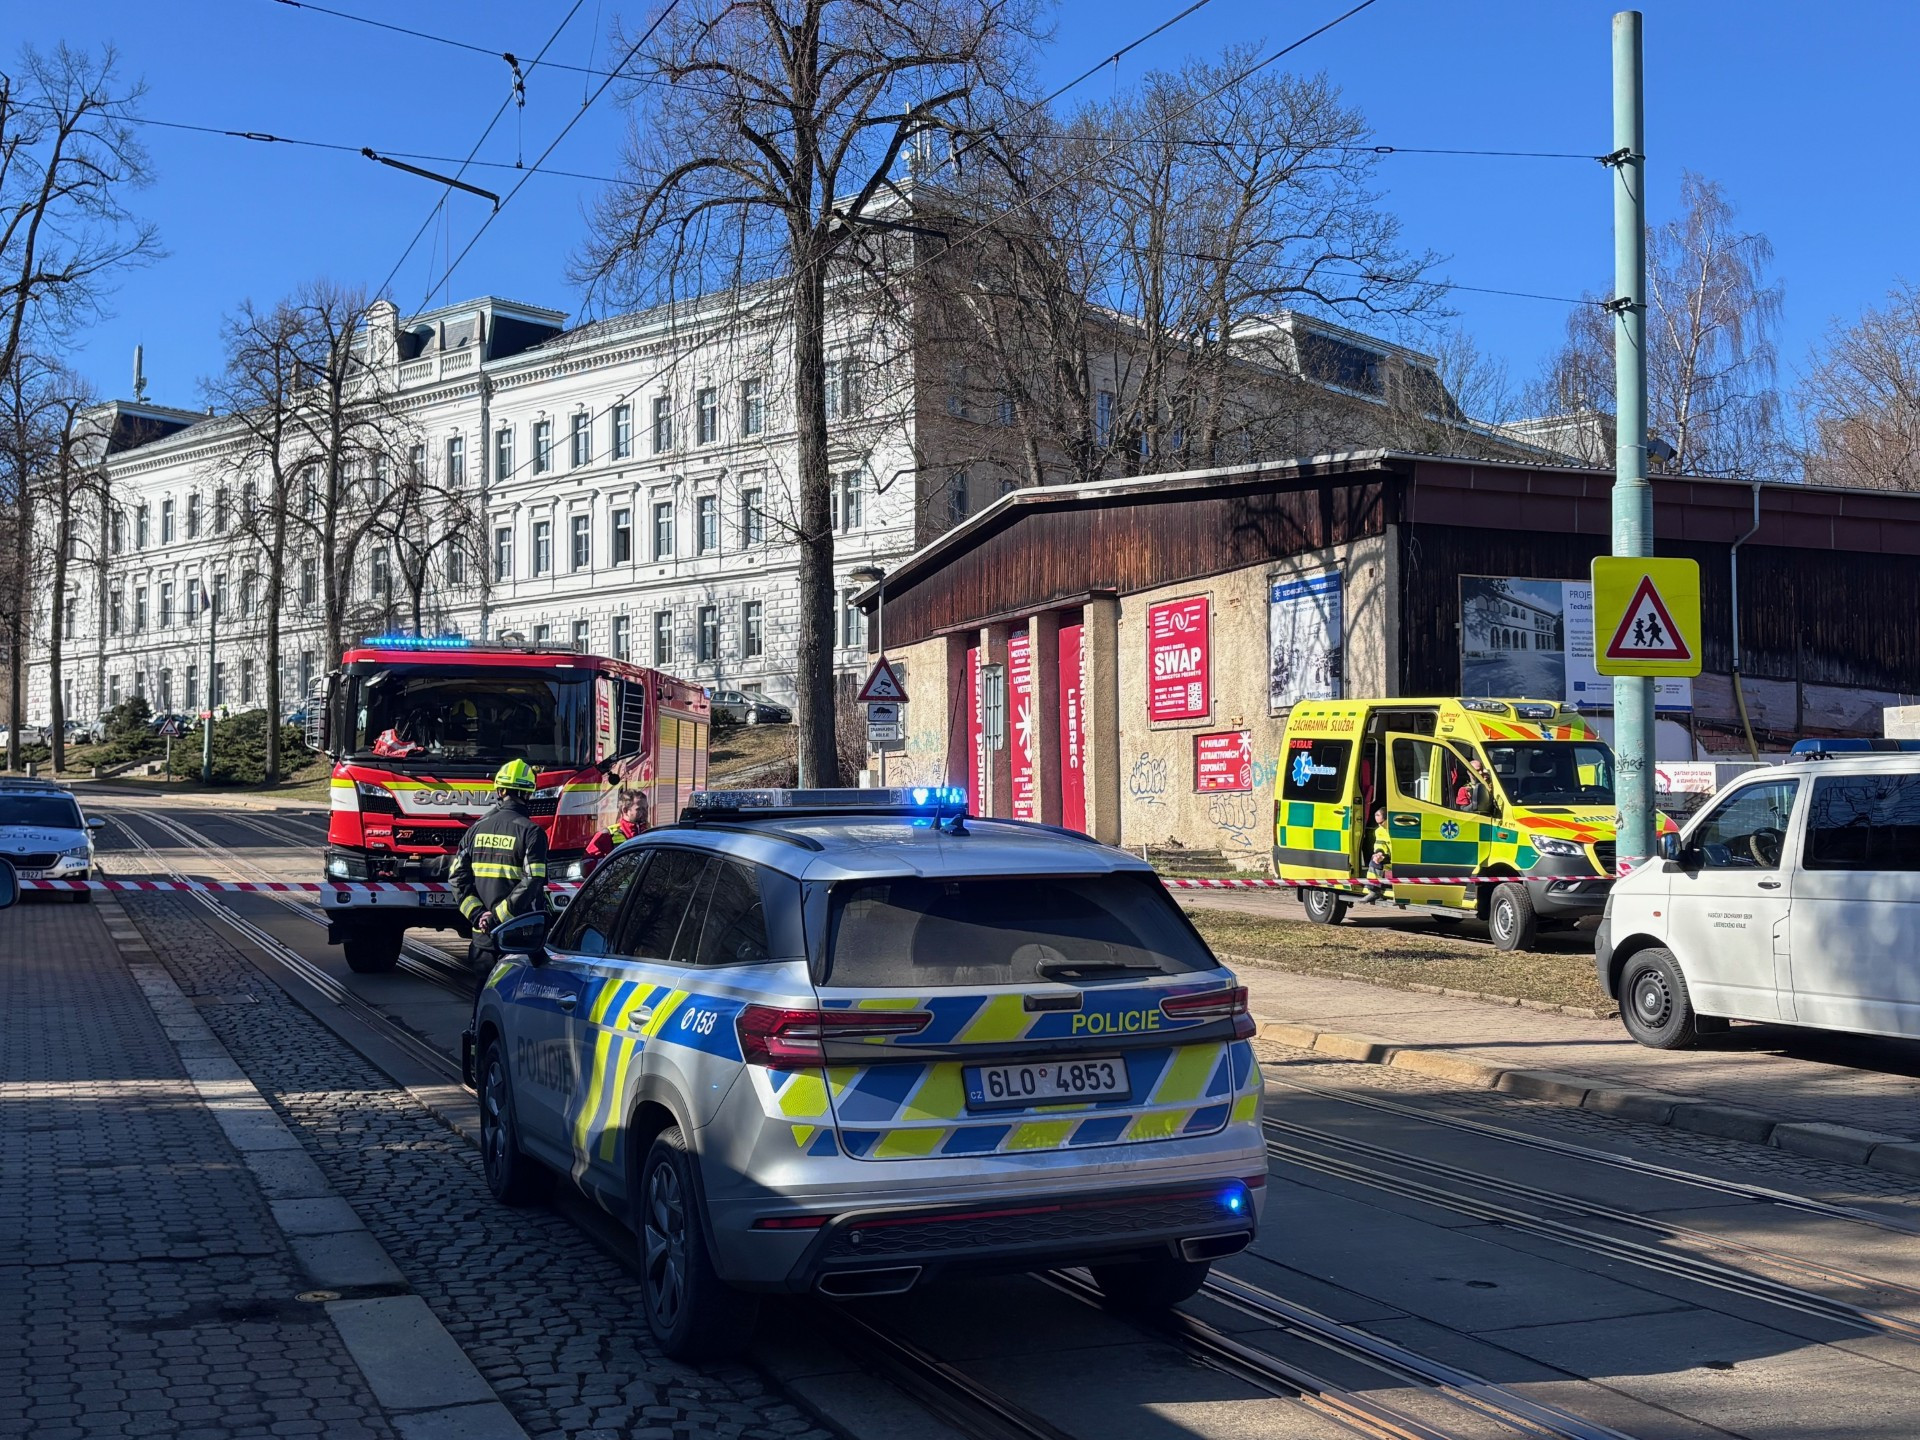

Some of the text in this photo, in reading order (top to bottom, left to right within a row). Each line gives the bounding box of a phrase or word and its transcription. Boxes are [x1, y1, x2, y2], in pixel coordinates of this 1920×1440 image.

[1569, 590, 1592, 599] PROJE
[1154, 646, 1201, 676] SWAP
[1067, 688, 1078, 769] LIBEREC
[1330, 718, 1355, 731] SLUŽBA
[1297, 740, 1313, 748] KRAJE
[975, 732, 986, 818] CHNICKÉ
[413, 789, 499, 806] SCANIA
[1573, 815, 1616, 823] AMBU
[0, 833, 59, 842] OLICIE
[428, 893, 446, 904] 3L2
[692, 1011, 718, 1036] 158
[1071, 1008, 1160, 1034] POLICIE
[516, 1035, 573, 1094] POLICIE
[1056, 1063, 1116, 1093] 4853
[970, 1090, 983, 1100] CZ
